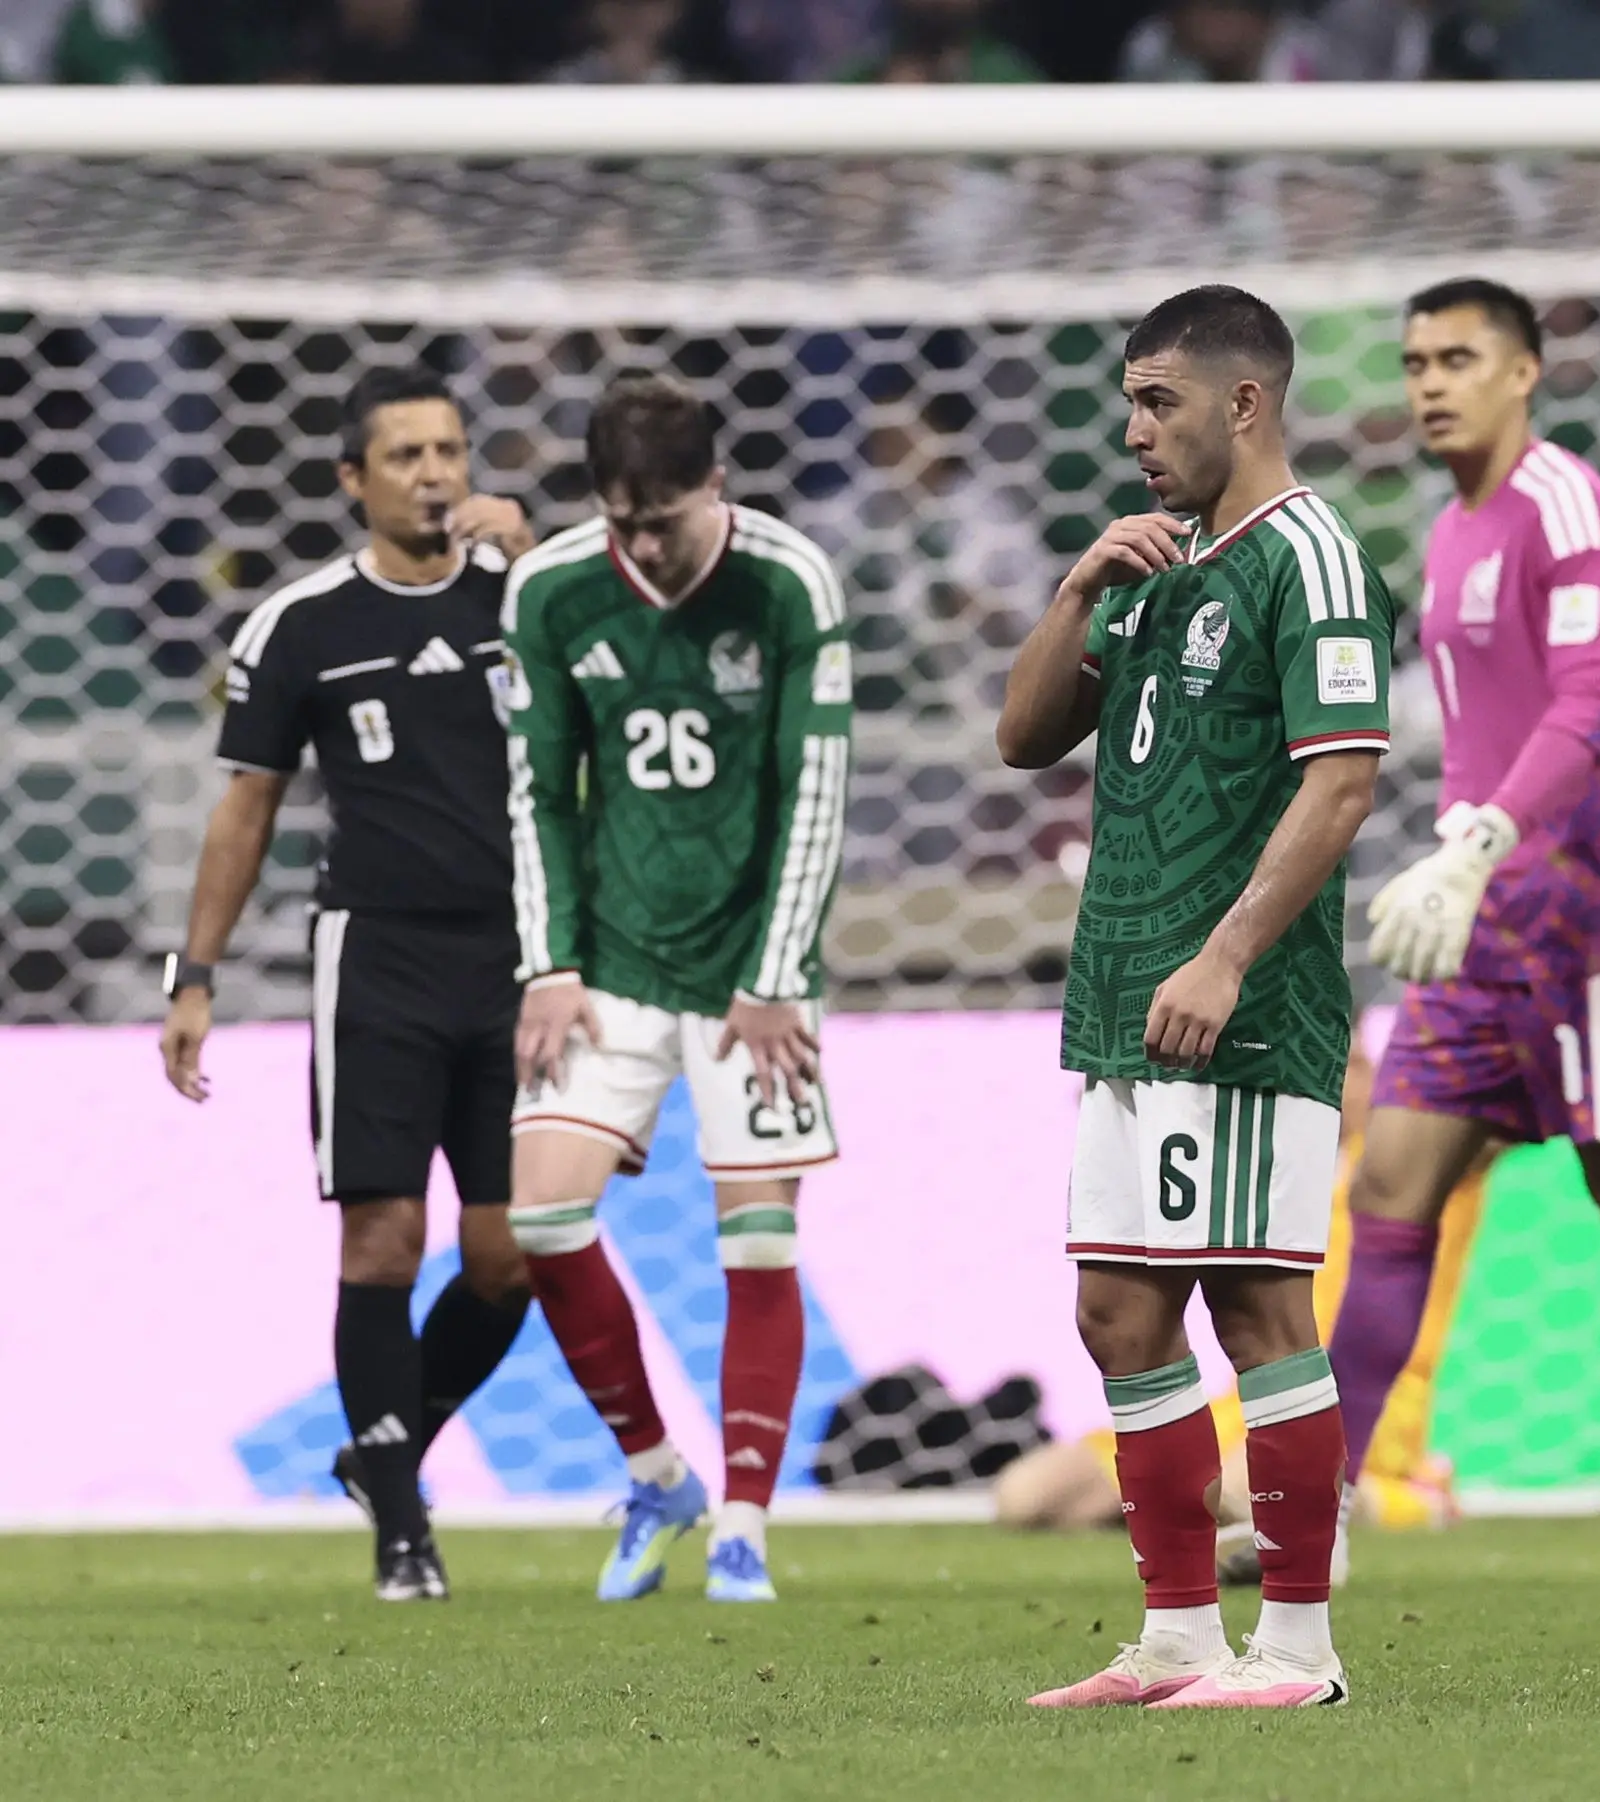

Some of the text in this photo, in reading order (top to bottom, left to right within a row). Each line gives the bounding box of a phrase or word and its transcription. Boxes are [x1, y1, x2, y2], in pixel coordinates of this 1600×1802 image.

[1130, 674, 1158, 764] 6
[1327, 678, 1367, 689] EDUCATION
[624, 708, 716, 790] 26
[1553, 1023, 1584, 1104] 1
[1159, 1132, 1198, 1222] 6
